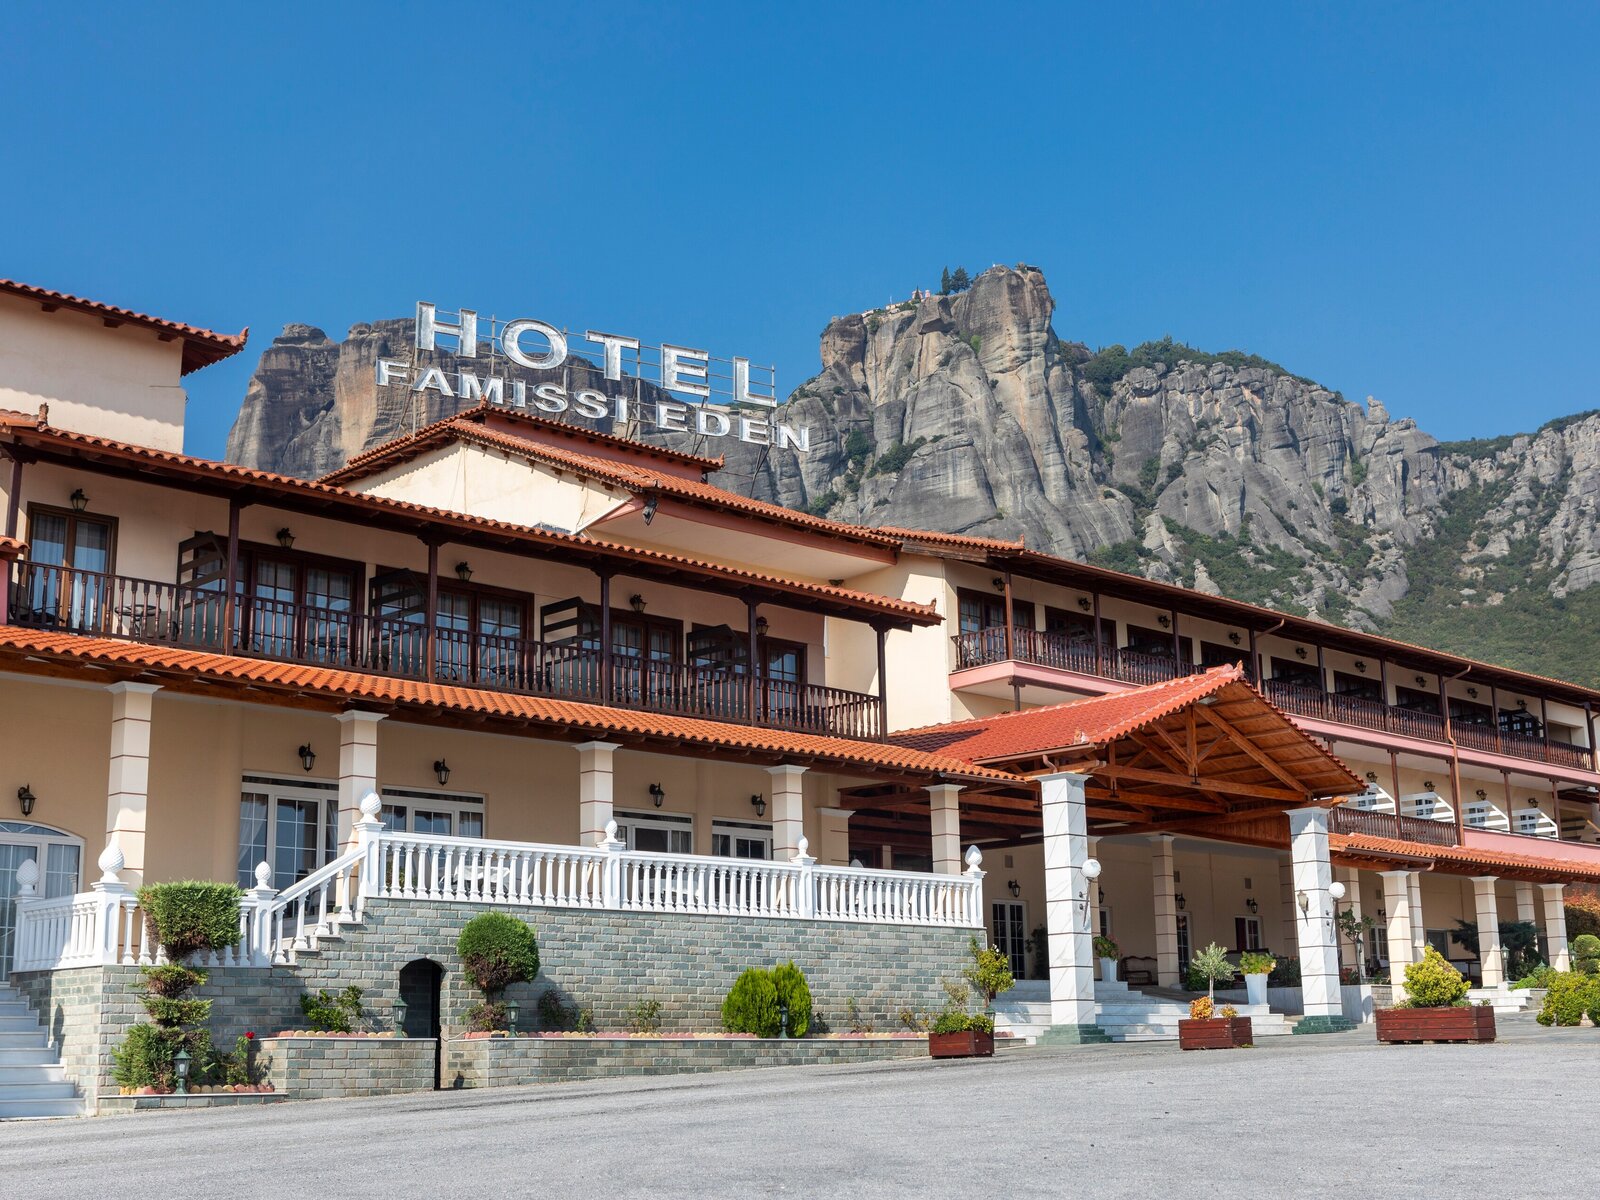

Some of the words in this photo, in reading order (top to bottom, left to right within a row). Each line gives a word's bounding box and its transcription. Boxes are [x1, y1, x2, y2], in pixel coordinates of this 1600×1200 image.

[376, 357, 628, 424] FAMISSI
[656, 401, 810, 453] EDEN
[416, 301, 777, 408] HOTEL
